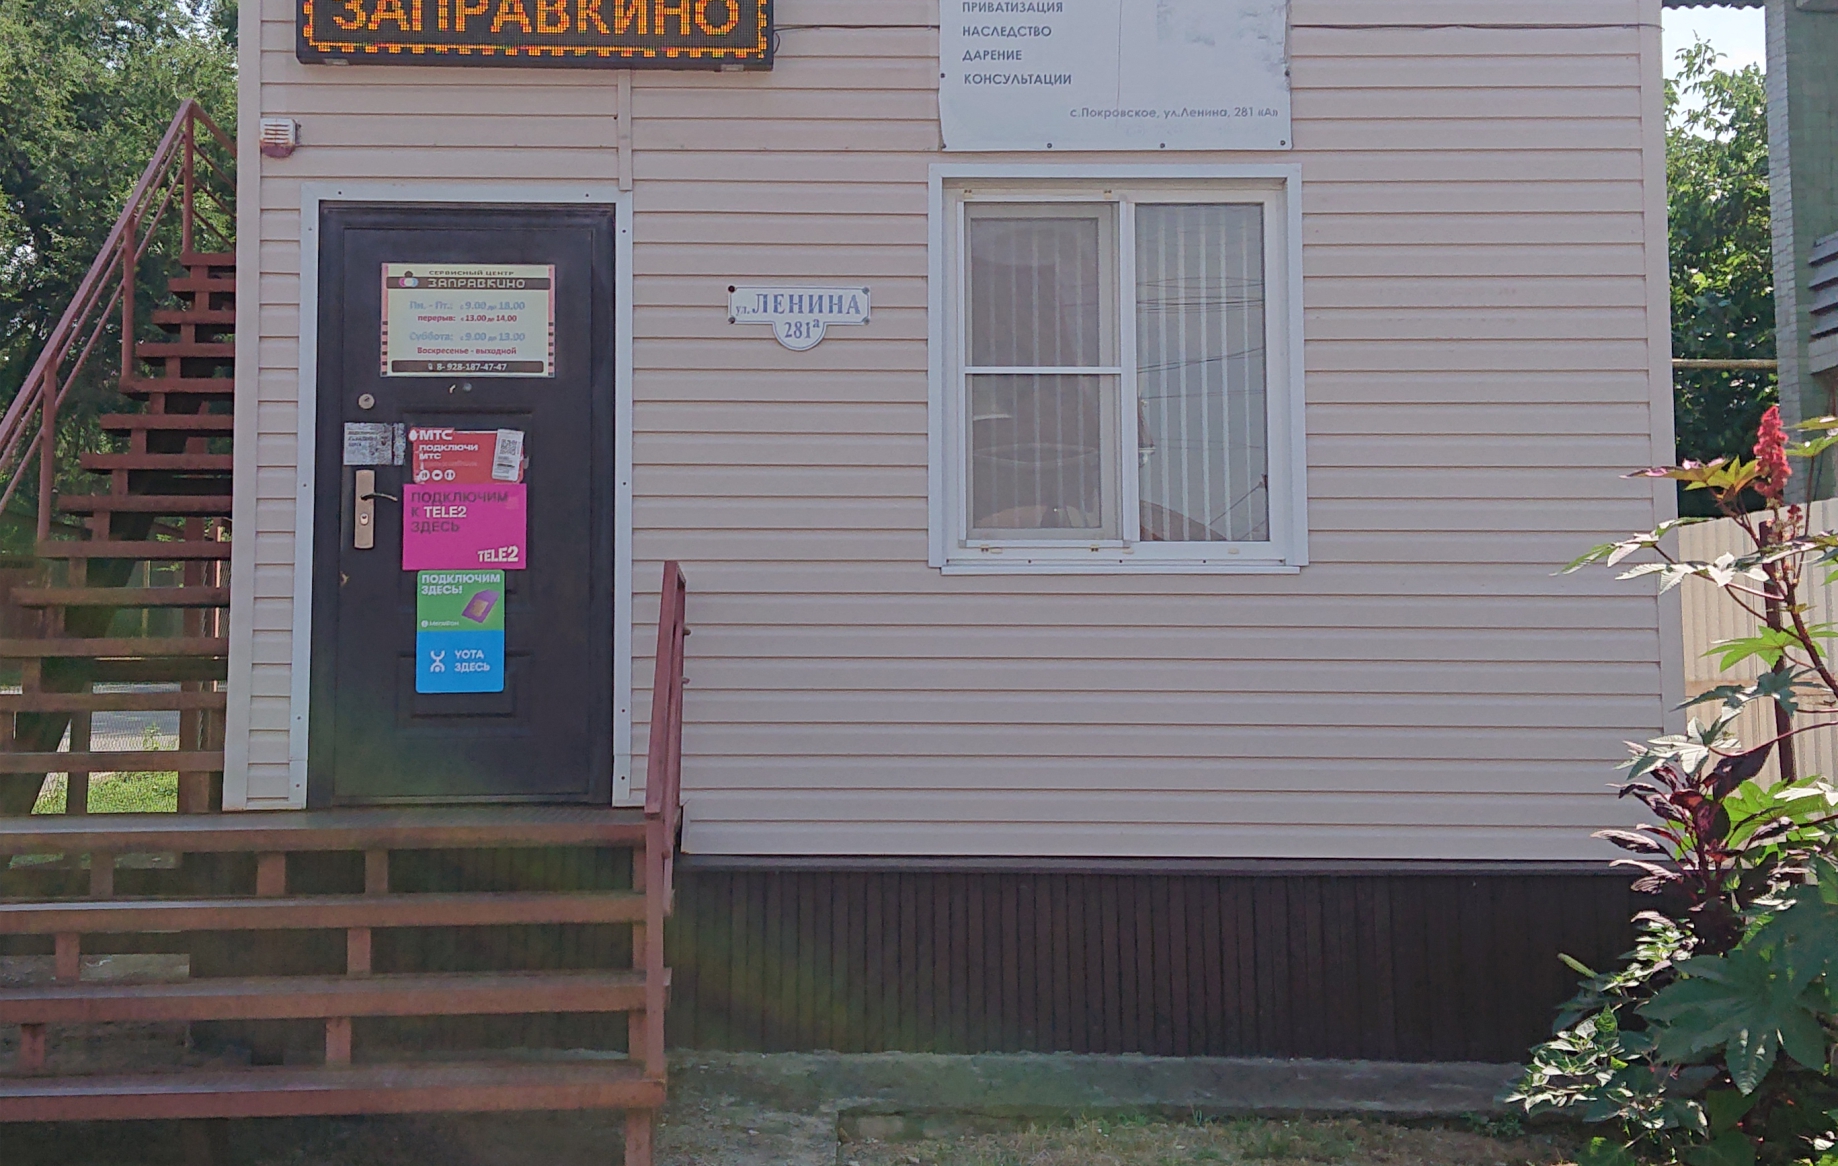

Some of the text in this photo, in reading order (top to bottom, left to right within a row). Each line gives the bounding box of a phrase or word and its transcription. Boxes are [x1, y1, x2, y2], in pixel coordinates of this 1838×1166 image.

[962, 2, 1063, 14] ПРИВАТИЗАЦИЯ
[962, 26, 1051, 39] НАСЛЕДСТВО
[962, 50, 1022, 62] ДАРЕНИЕ
[964, 74, 1072, 87] КОНСУЛЬТАЦИИ
[1235, 107, 1253, 117] 281
[428, 279, 525, 288] ЗАПРАВКИНО
[465, 302, 486, 310] 9.00
[736, 293, 861, 316] ул. ЛЕНИНА
[409, 332, 453, 342] Суббота:
[465, 333, 486, 341] 9.00
[417, 347, 468, 355] Воскресенье
[476, 347, 516, 356] выходной
[420, 430, 453, 440] МТС
[411, 492, 508, 505] ПОДКЛЮЧИМ
[424, 506, 467, 518] TELE2
[411, 521, 460, 534] ЗДЕСЬ
[478, 546, 519, 562] TELE2
[421, 574, 500, 584] ПОДКЛЮЧИМ
[421, 586, 462, 595] ЗДЕСЬ!
[454, 650, 484, 659] YOTA
[454, 662, 490, 672] ЗДЕСЬ
